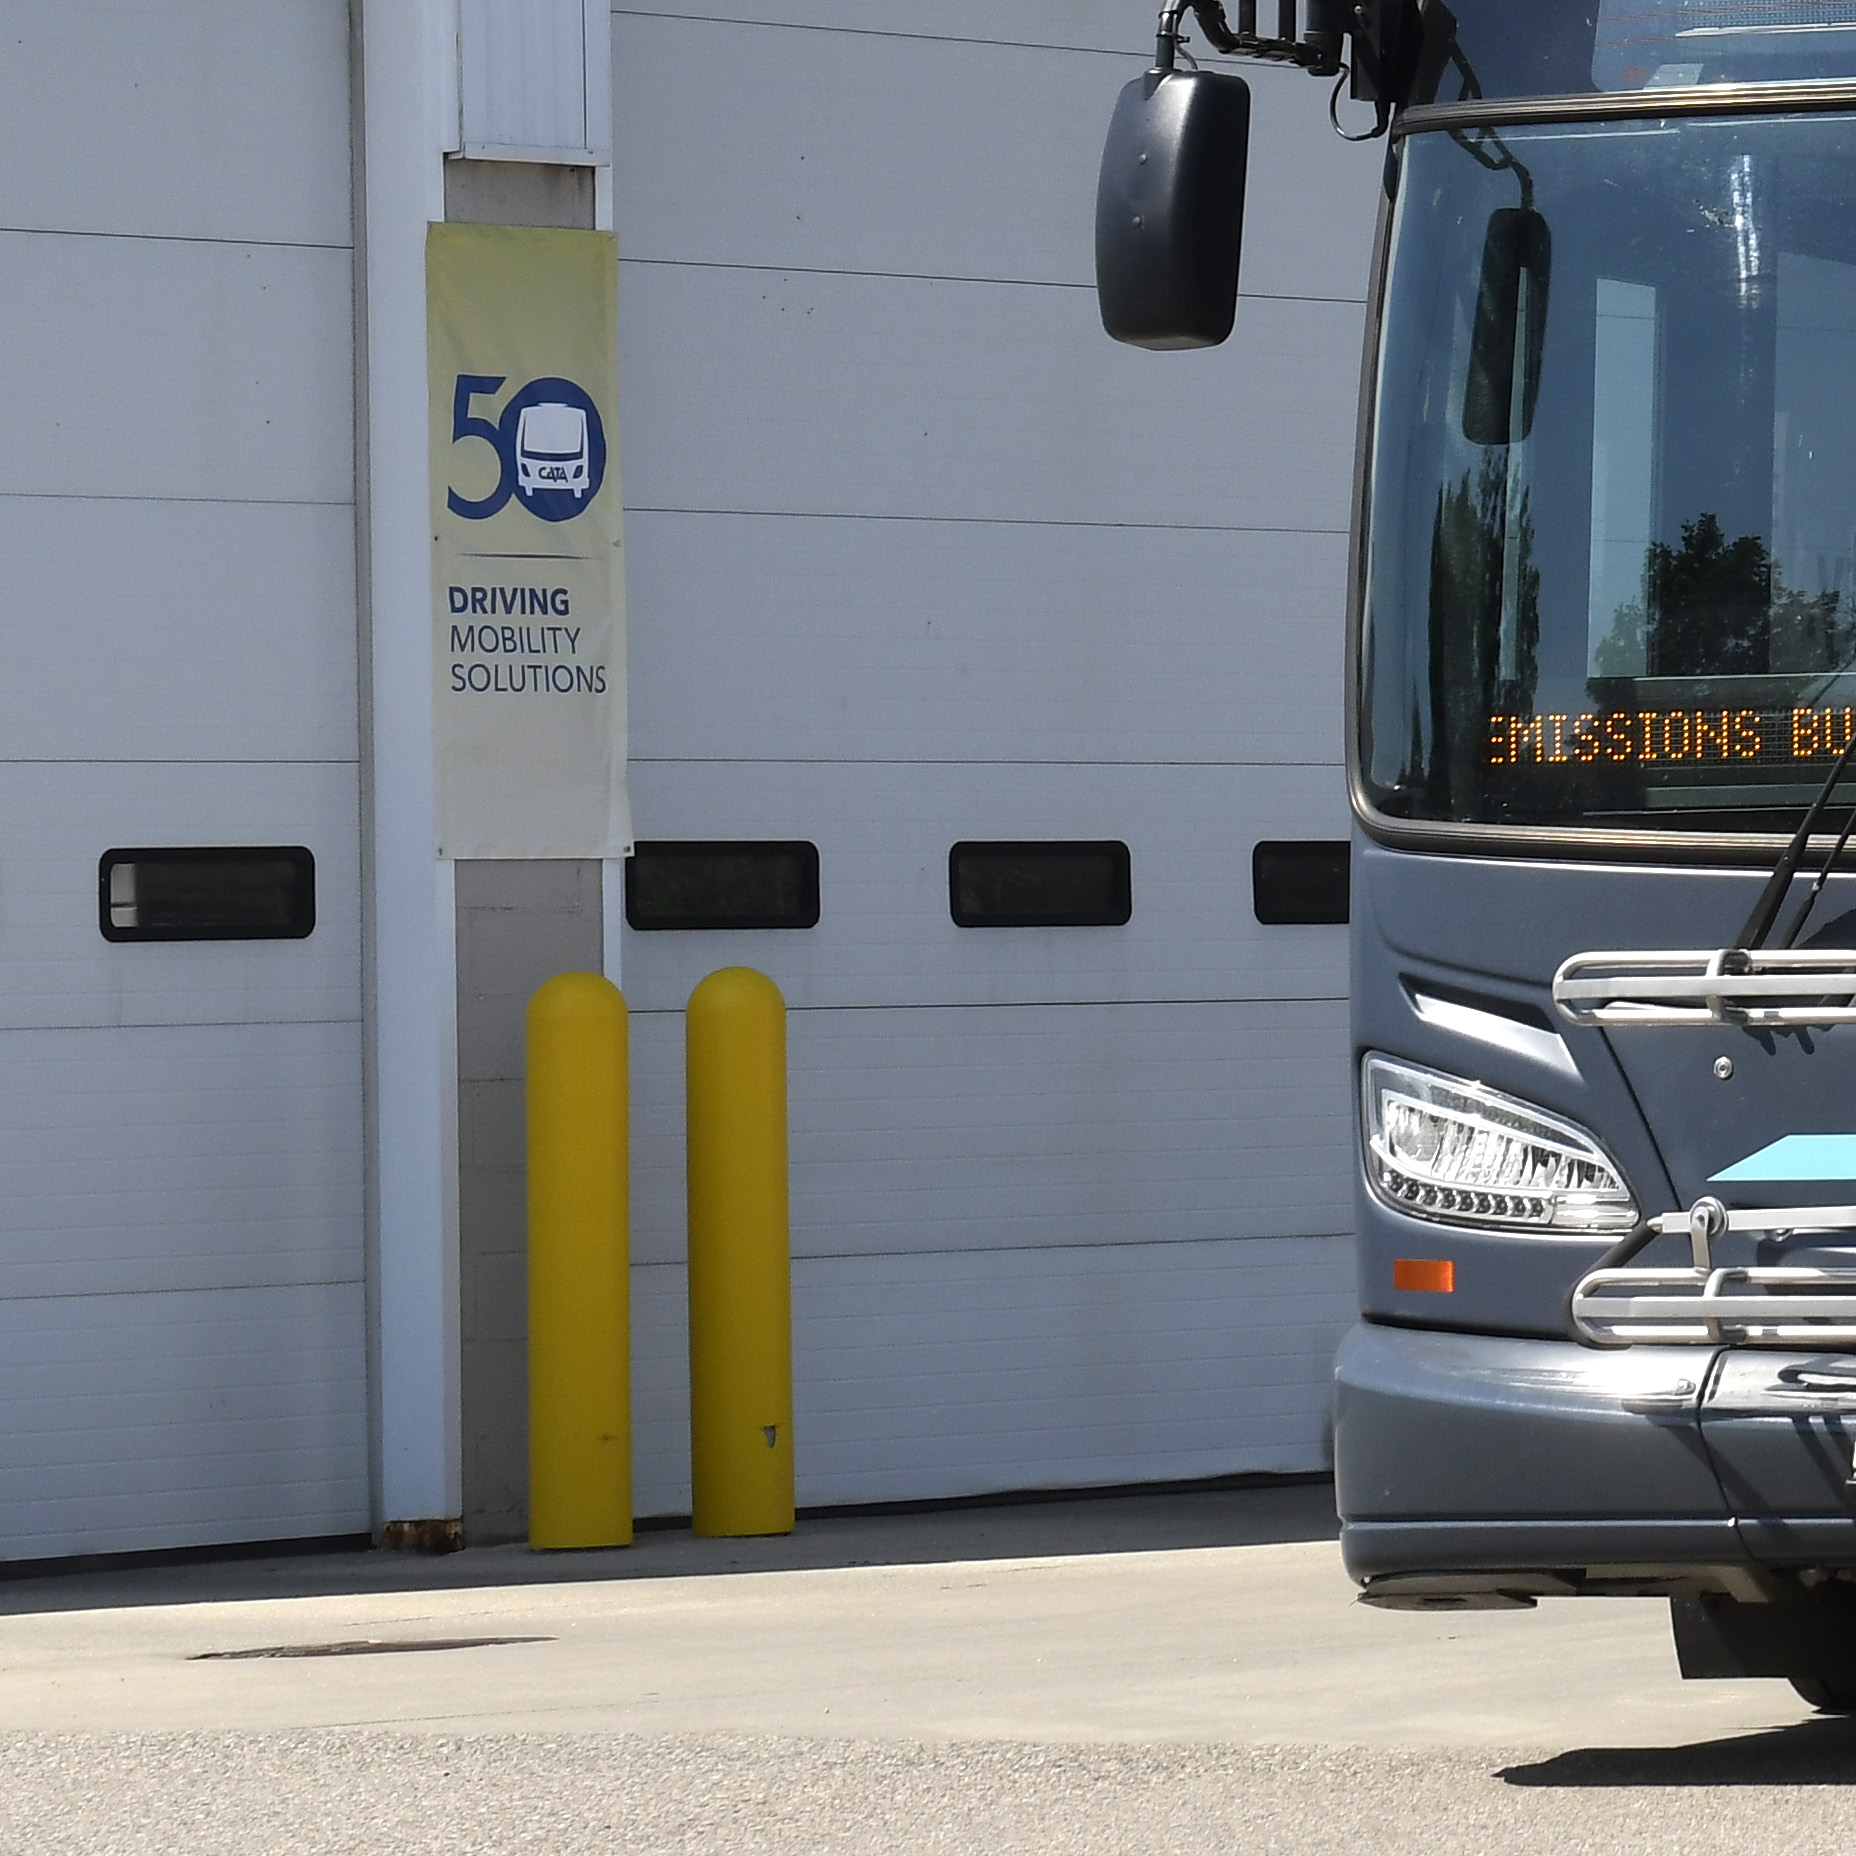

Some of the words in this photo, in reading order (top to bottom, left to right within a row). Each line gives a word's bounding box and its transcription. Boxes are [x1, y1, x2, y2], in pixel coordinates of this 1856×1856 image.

[447, 374, 607, 522] 50
[538, 466, 569, 484] CATA
[449, 586, 570, 616] DRIVING
[450, 624, 581, 655] MOBILITY
[450, 663, 607, 694] SOLUTIONS
